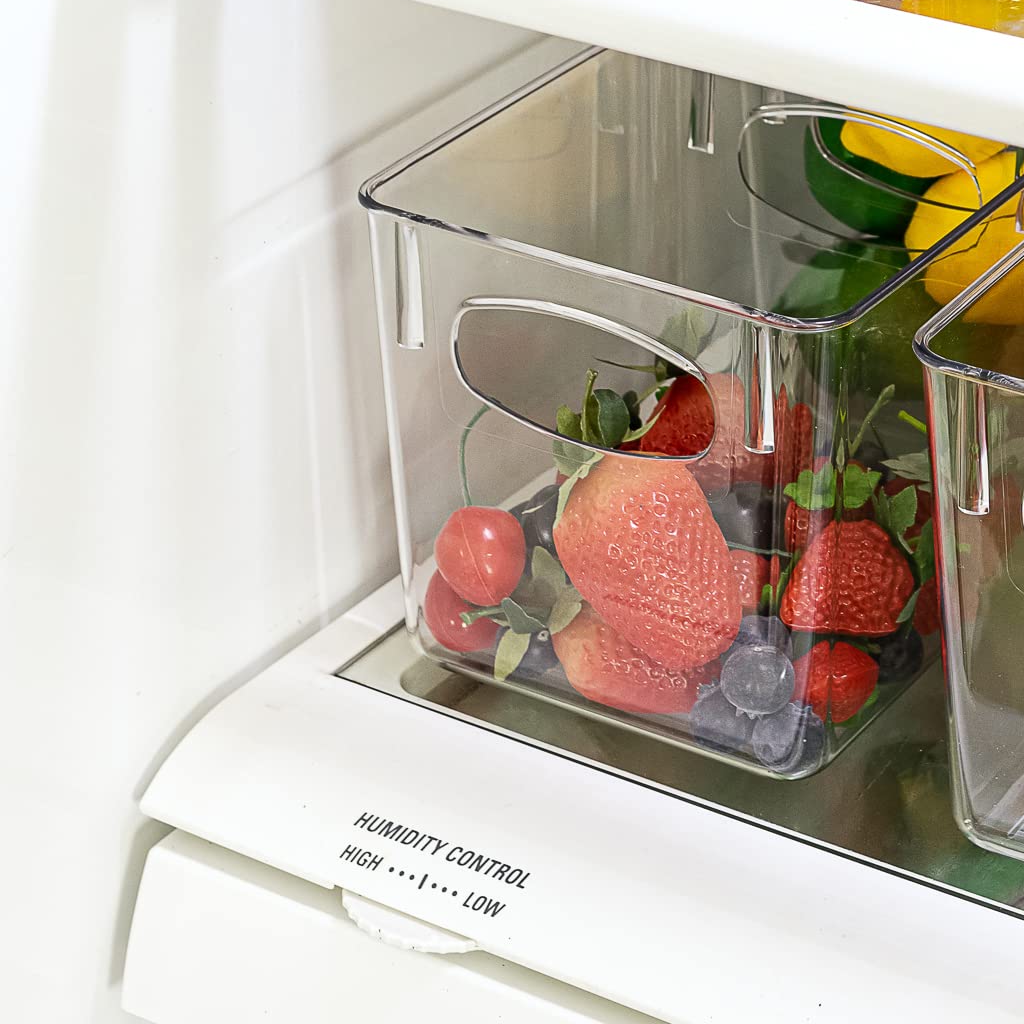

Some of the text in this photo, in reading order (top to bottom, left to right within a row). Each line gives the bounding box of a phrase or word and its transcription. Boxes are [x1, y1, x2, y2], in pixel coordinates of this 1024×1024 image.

[339, 844, 384, 871] HIGH
[353, 812, 531, 889] HUMIDITY CONTROL
[462, 892, 506, 917] LOW
